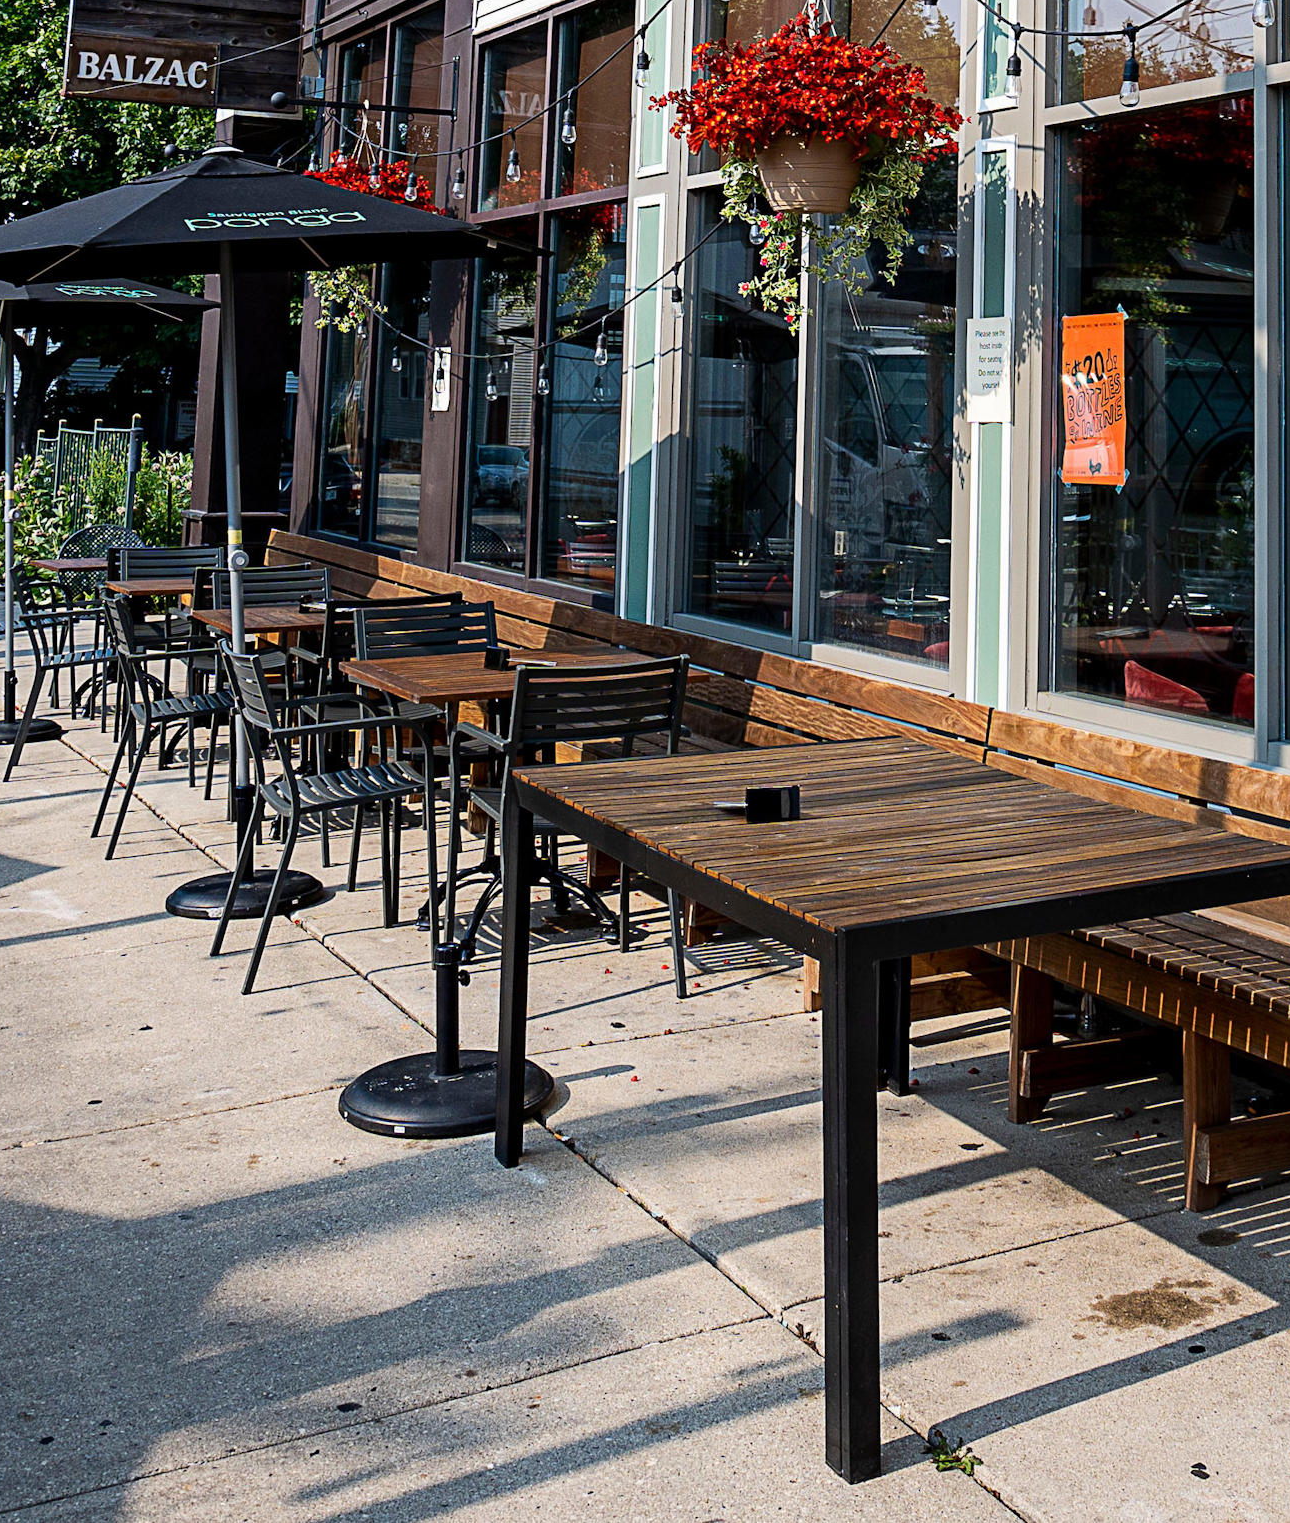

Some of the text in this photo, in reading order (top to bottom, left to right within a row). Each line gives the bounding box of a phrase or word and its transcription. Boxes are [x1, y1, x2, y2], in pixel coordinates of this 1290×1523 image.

[77, 51, 208, 89] BALZAC
[183, 211, 367, 232] ponga
[207, 207, 329, 219] Sauvignon Blanc
[1067, 372, 1122, 422] BOTTLES
